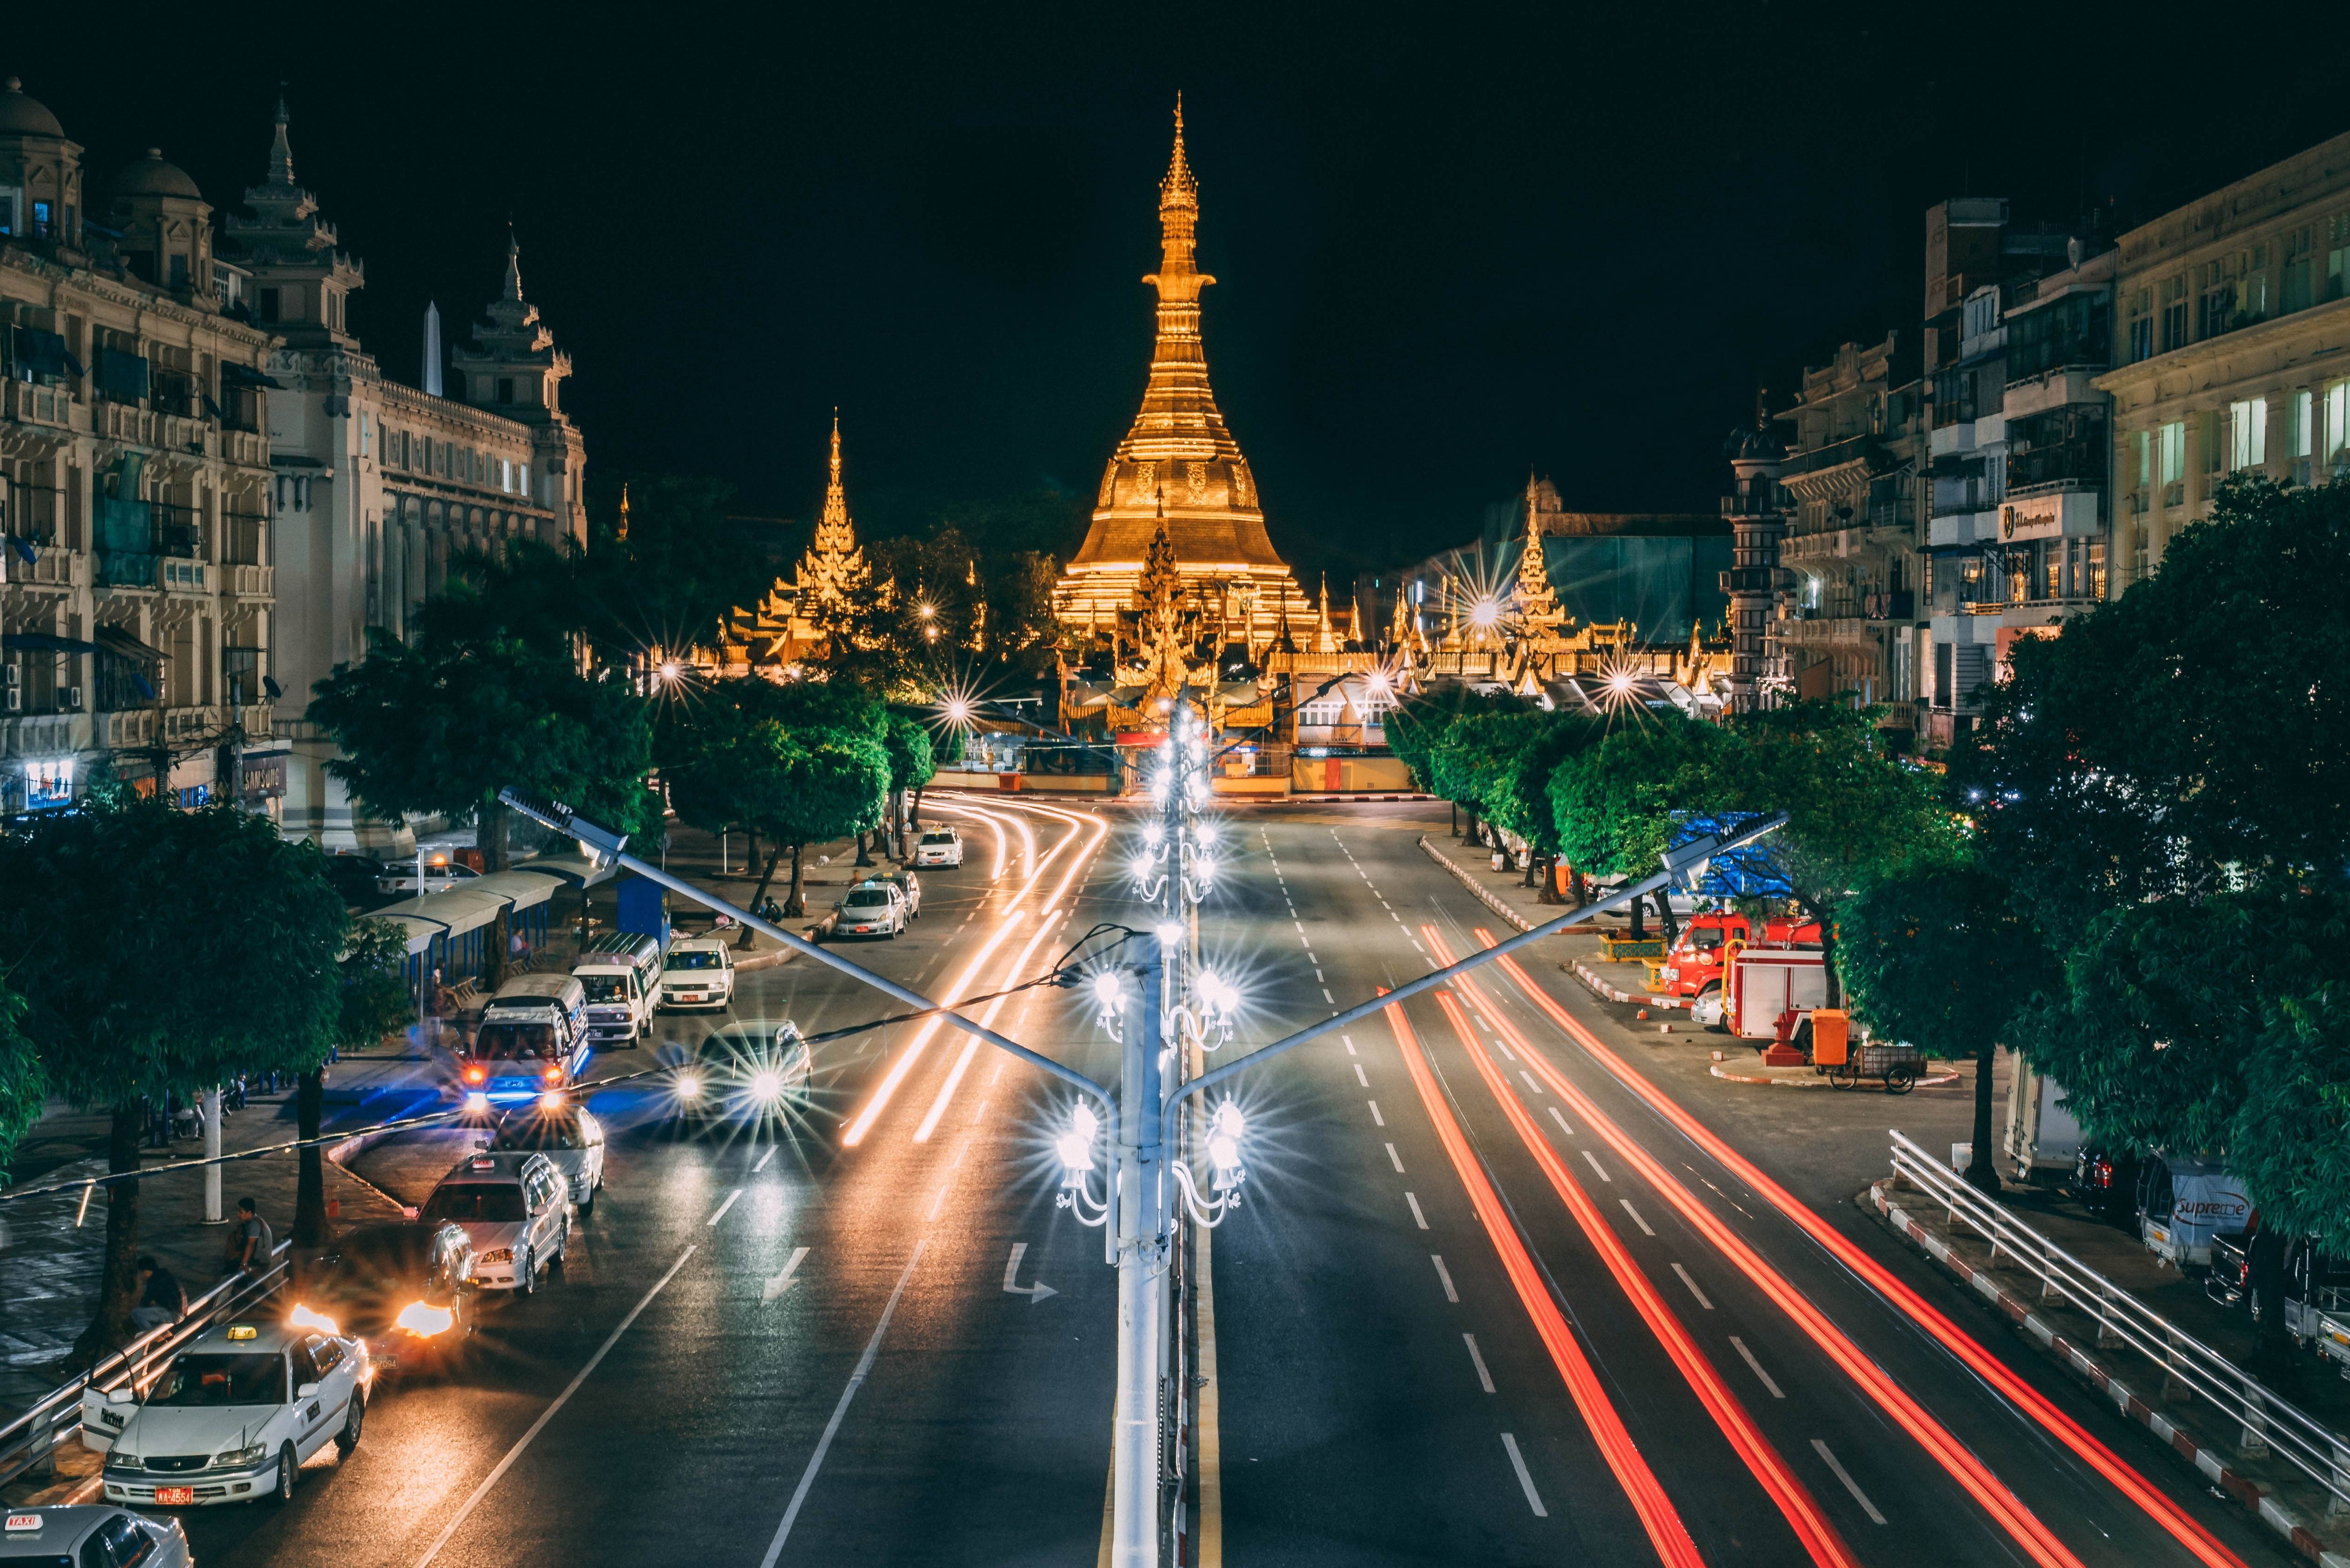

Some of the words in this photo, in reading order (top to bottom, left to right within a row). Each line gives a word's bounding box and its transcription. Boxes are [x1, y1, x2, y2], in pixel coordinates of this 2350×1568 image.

[245, 767, 279, 791] SAMSUNG
[2176, 1198, 2245, 1218] Supreme
[158, 1493, 190, 1503] AA-4554
[9, 1516, 36, 1526] TAXI
